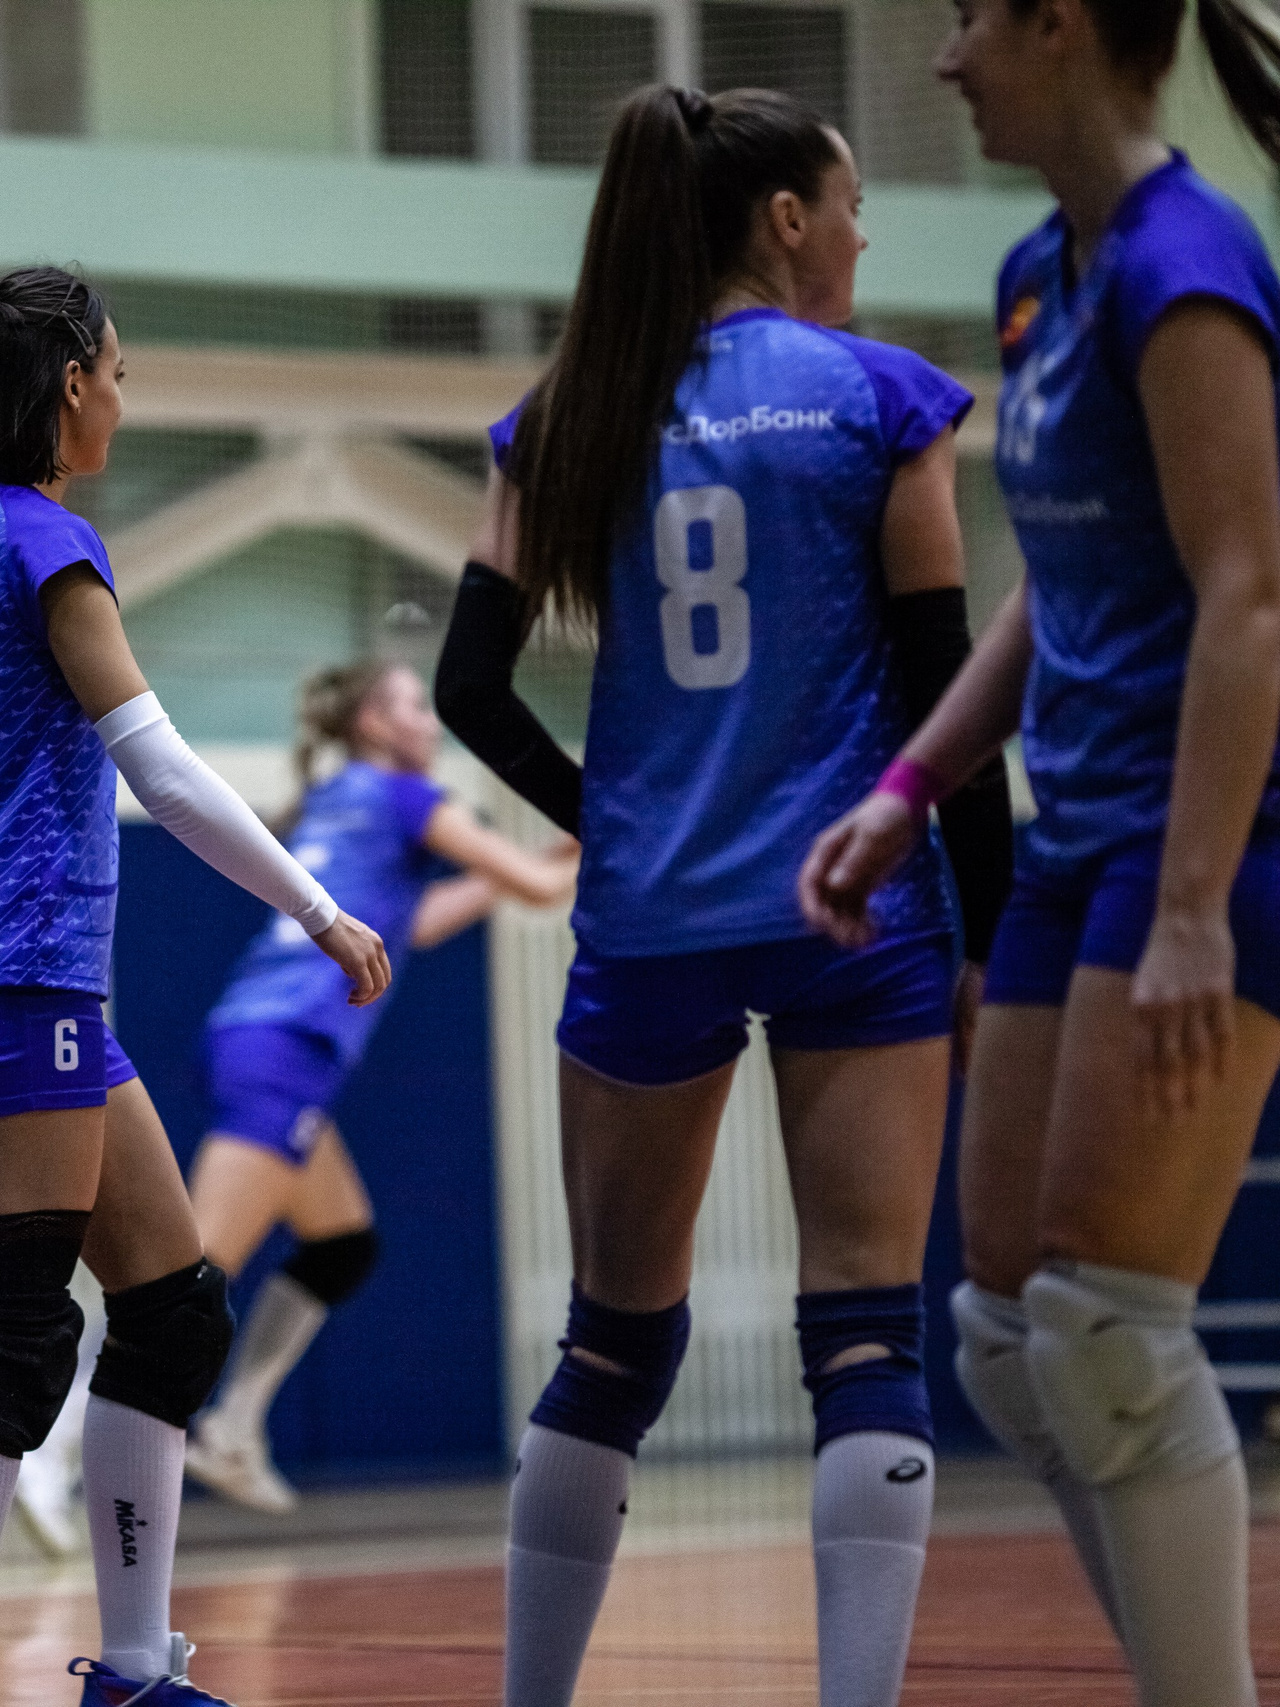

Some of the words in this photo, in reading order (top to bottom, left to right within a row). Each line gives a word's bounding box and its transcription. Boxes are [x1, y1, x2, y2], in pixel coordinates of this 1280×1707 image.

[663, 405, 836, 444] сДорБанк
[654, 485, 751, 689] 8
[55, 1018, 79, 1071] 6
[114, 1499, 148, 1568] MIKASA
